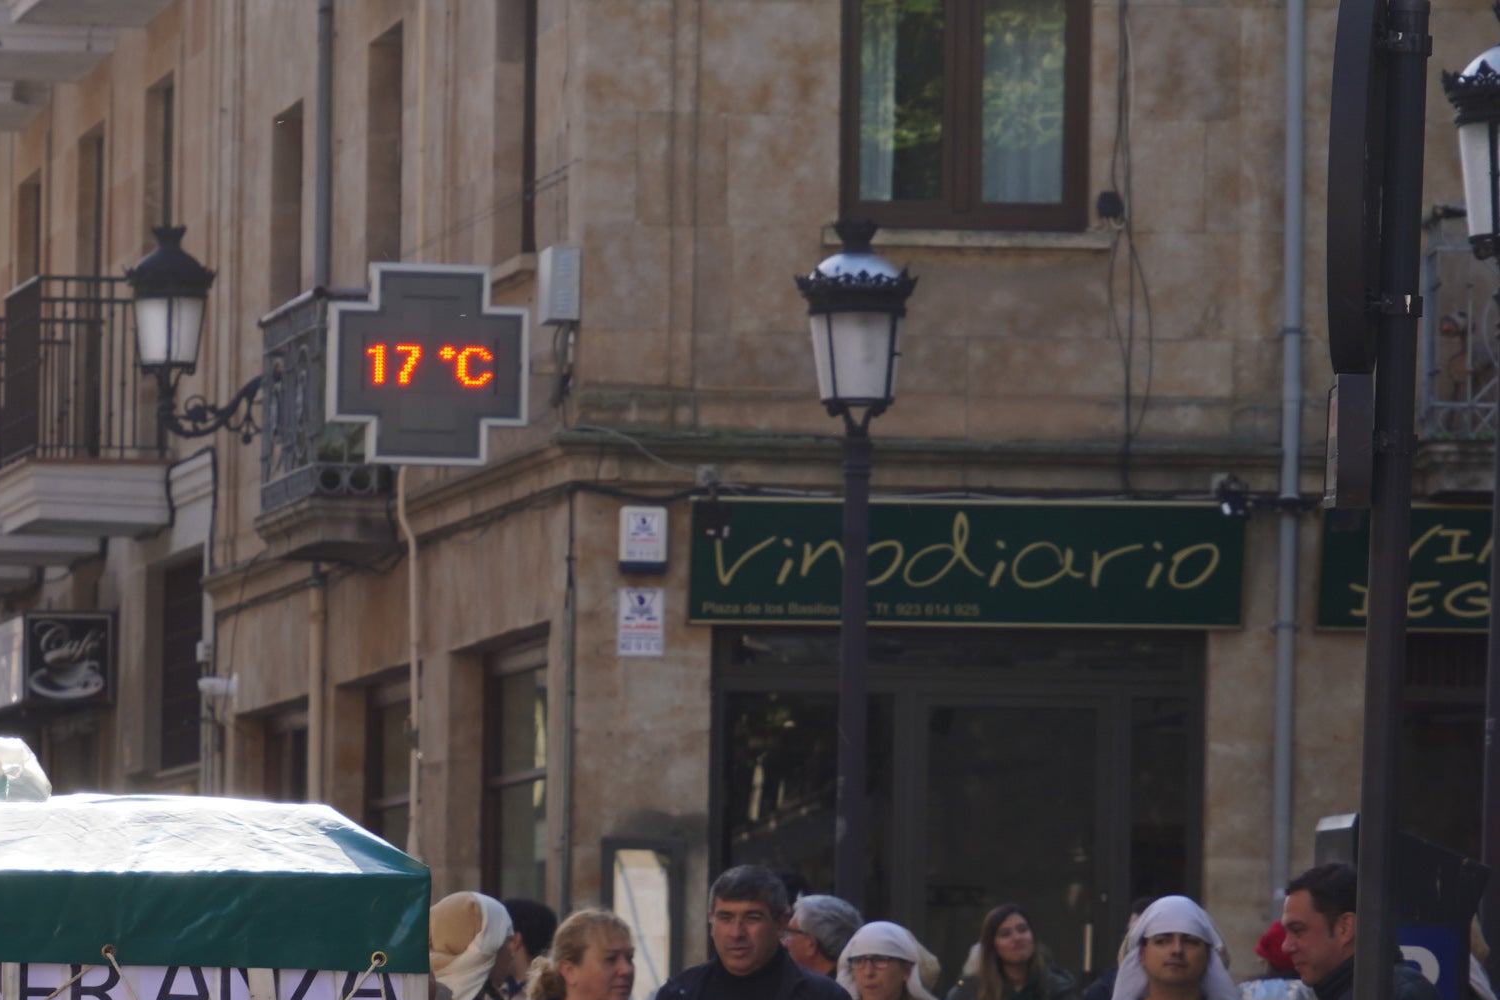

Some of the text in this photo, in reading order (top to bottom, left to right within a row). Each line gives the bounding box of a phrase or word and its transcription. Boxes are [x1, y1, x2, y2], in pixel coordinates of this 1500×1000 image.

[365, 344, 493, 386] 17 °C
[702, 601, 740, 615] Plaza
[743, 602, 760, 615] de
[763, 602, 785, 615] los
